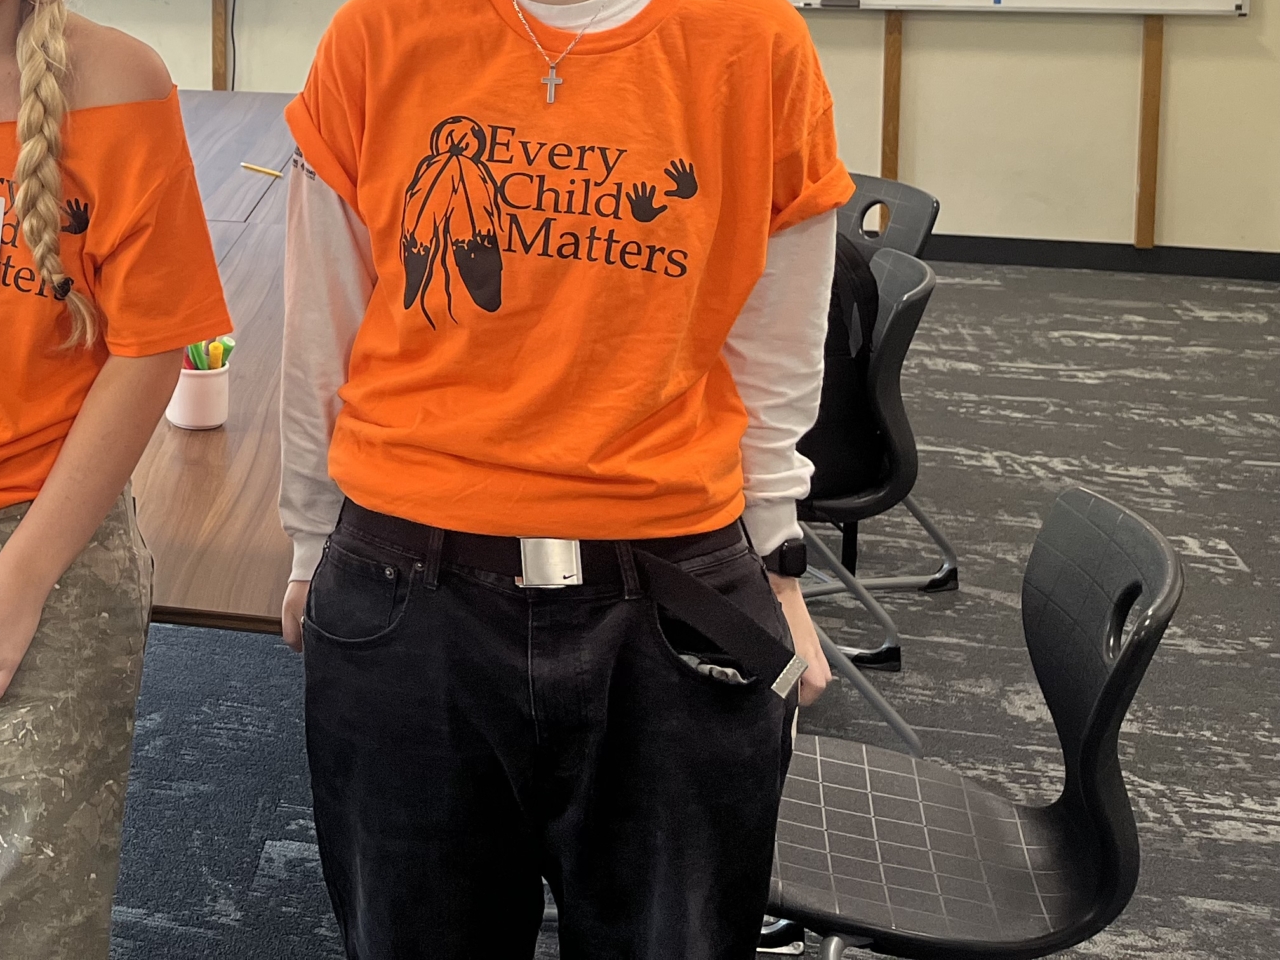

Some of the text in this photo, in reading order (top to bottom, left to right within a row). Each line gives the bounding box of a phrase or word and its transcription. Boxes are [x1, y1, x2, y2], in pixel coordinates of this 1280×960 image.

[486, 124, 628, 187] Every
[497, 172, 623, 221] Child
[502, 213, 690, 278] Matters
